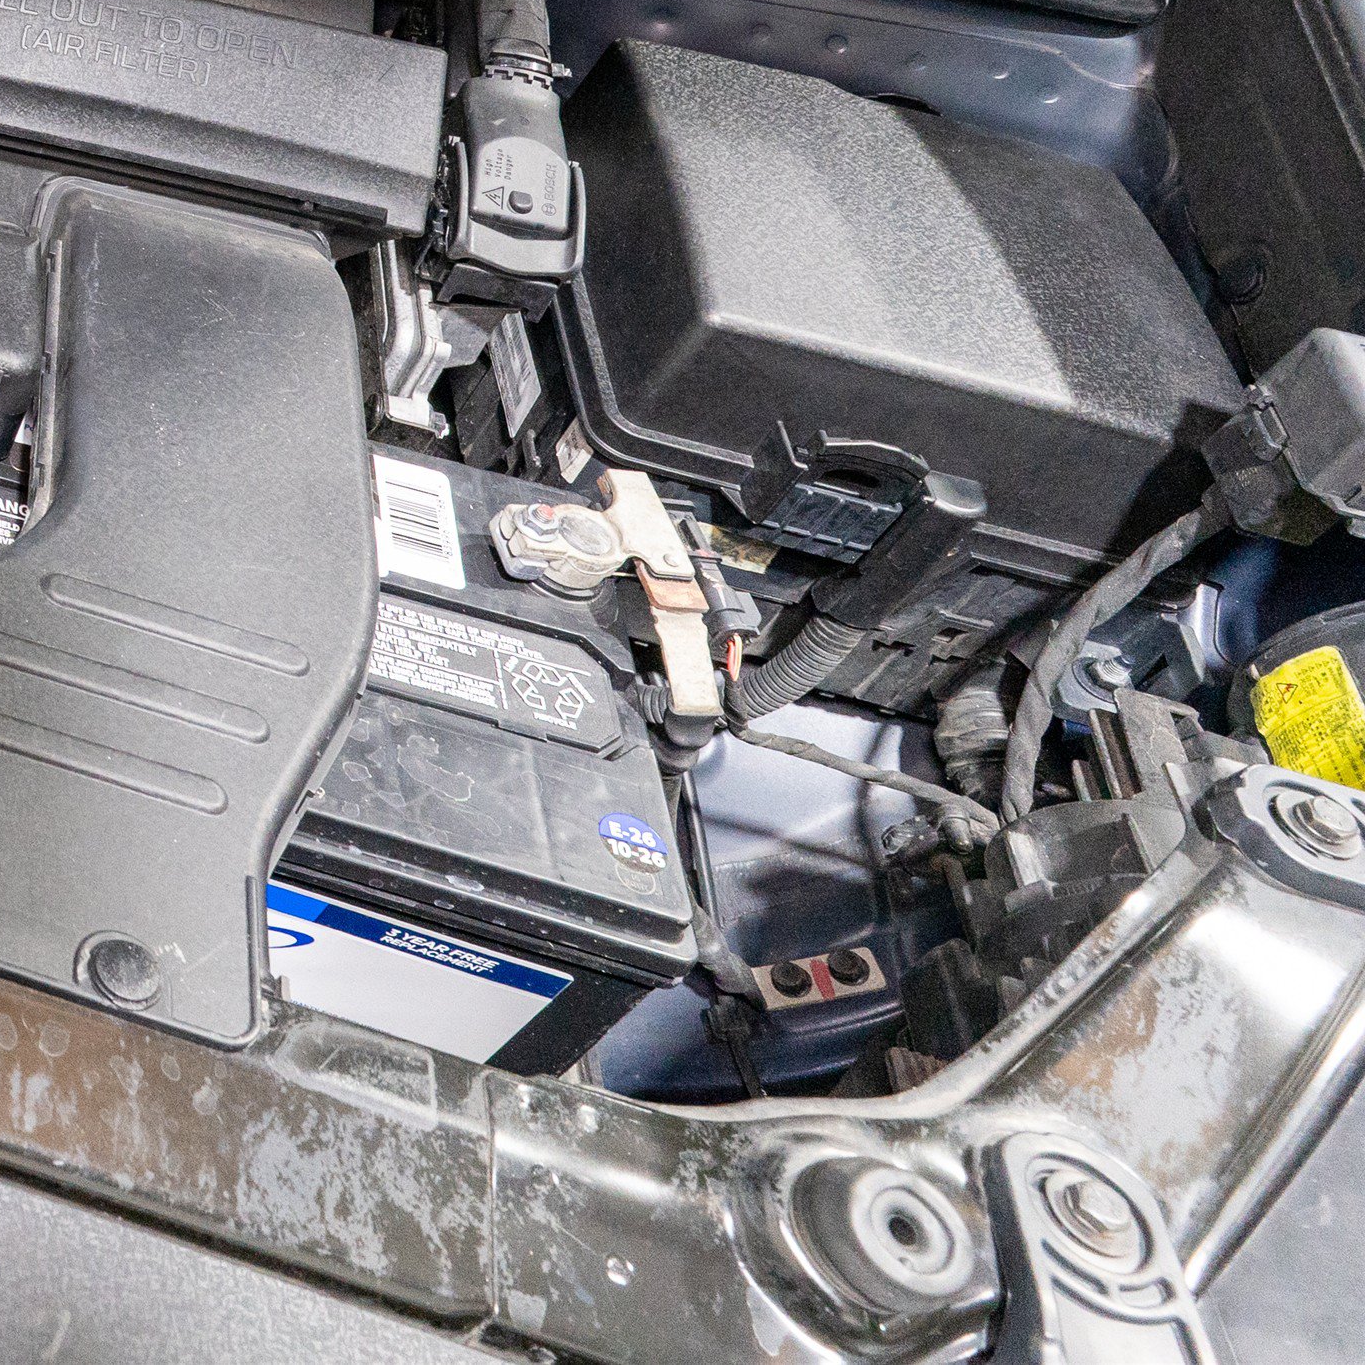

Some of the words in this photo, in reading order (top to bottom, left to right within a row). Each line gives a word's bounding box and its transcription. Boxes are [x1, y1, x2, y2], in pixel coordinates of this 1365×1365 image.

[137, 10, 184, 44] TO
[195, 23, 300, 70] OPEN
[485, 158, 494, 176] High
[495, 148, 505, 177] Voltage
[504, 155, 514, 181] Danger
[544, 163, 557, 202] BOSCH
[380, 623, 406, 637] EYES
[394, 644, 423, 659] HELP
[423, 652, 449, 667] FAST
[608, 820, 657, 848] E-26
[607, 838, 667, 869] 10-26
[385, 928, 402, 937] 3
[402, 932, 450, 953] YEAR
[449, 949, 500, 969] FREE
